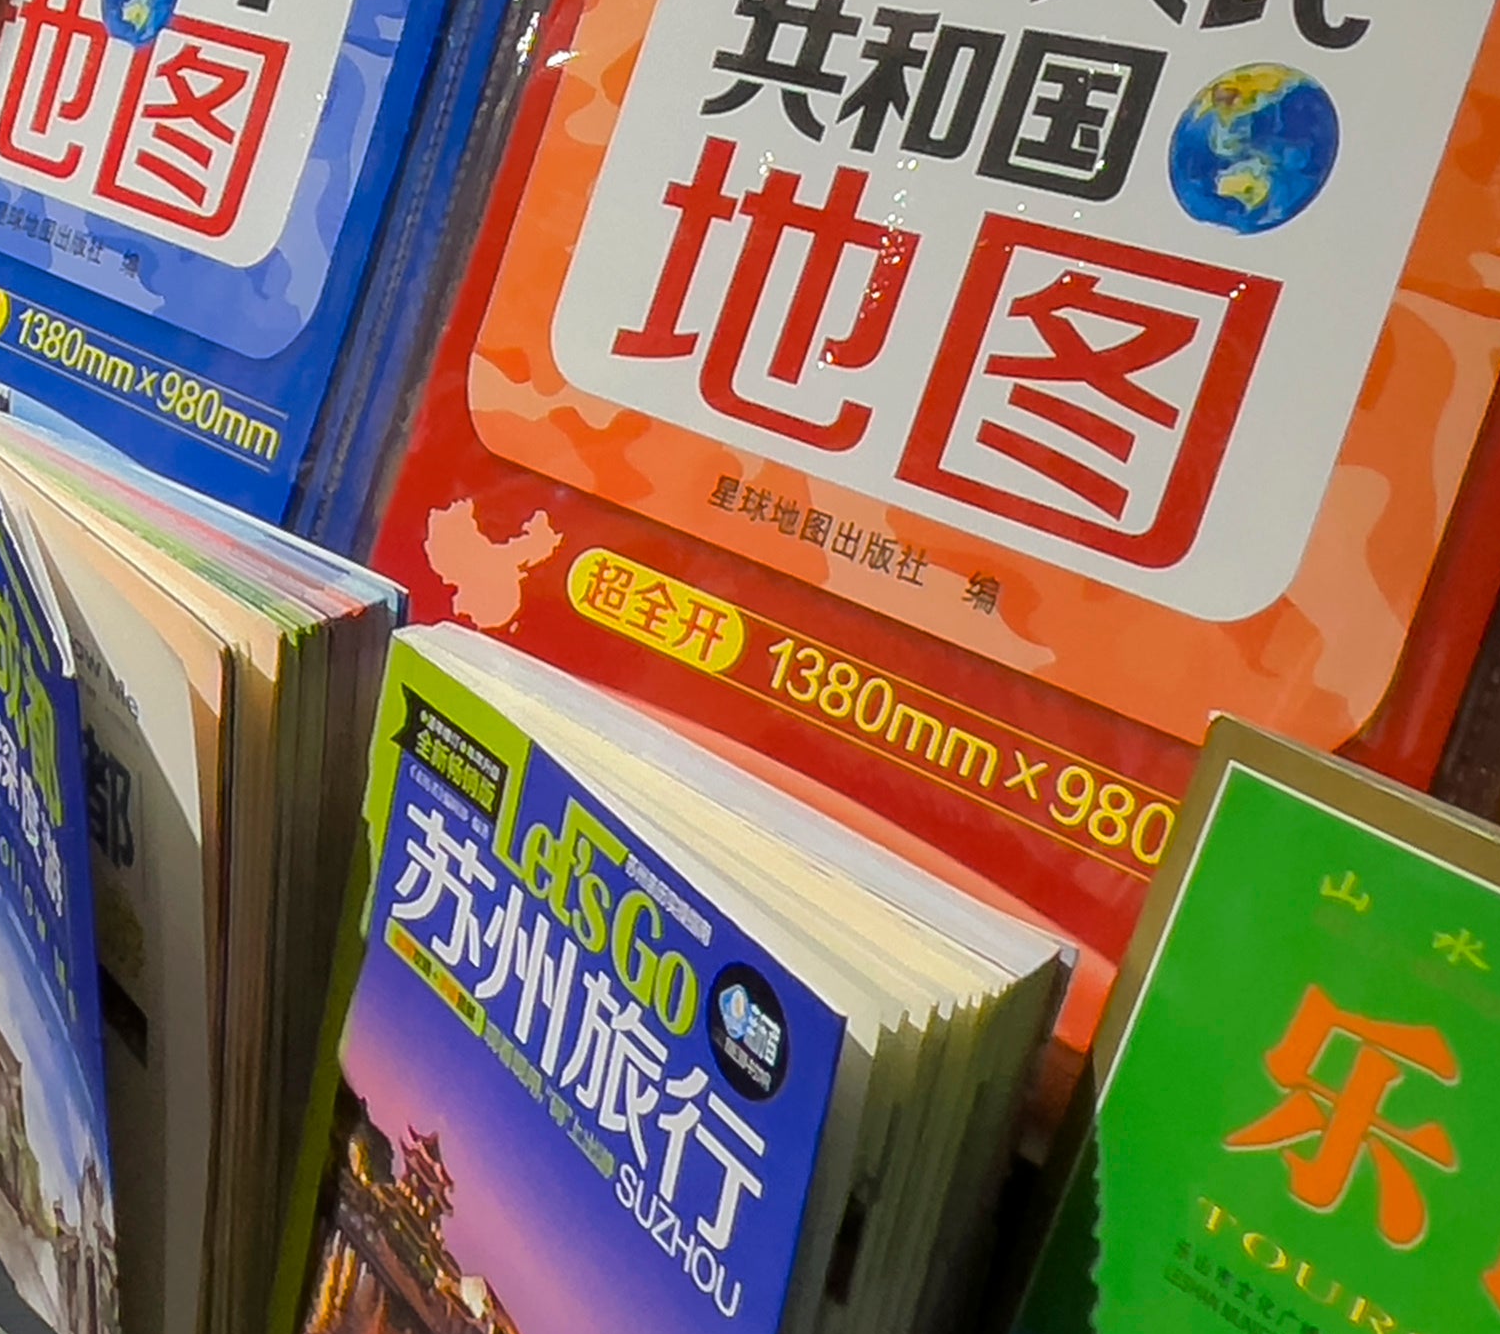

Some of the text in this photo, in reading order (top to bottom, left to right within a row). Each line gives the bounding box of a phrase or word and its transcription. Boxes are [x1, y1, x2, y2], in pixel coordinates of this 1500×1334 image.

[610, 134, 1284, 570] 地图
[580, 557, 728, 664] 超全开
[709, 474, 1001, 615] 星球地图出版社 编
[391, 804, 765, 1251] 苏州旅行
[615, 1164, 742, 1319] SUZHOU
